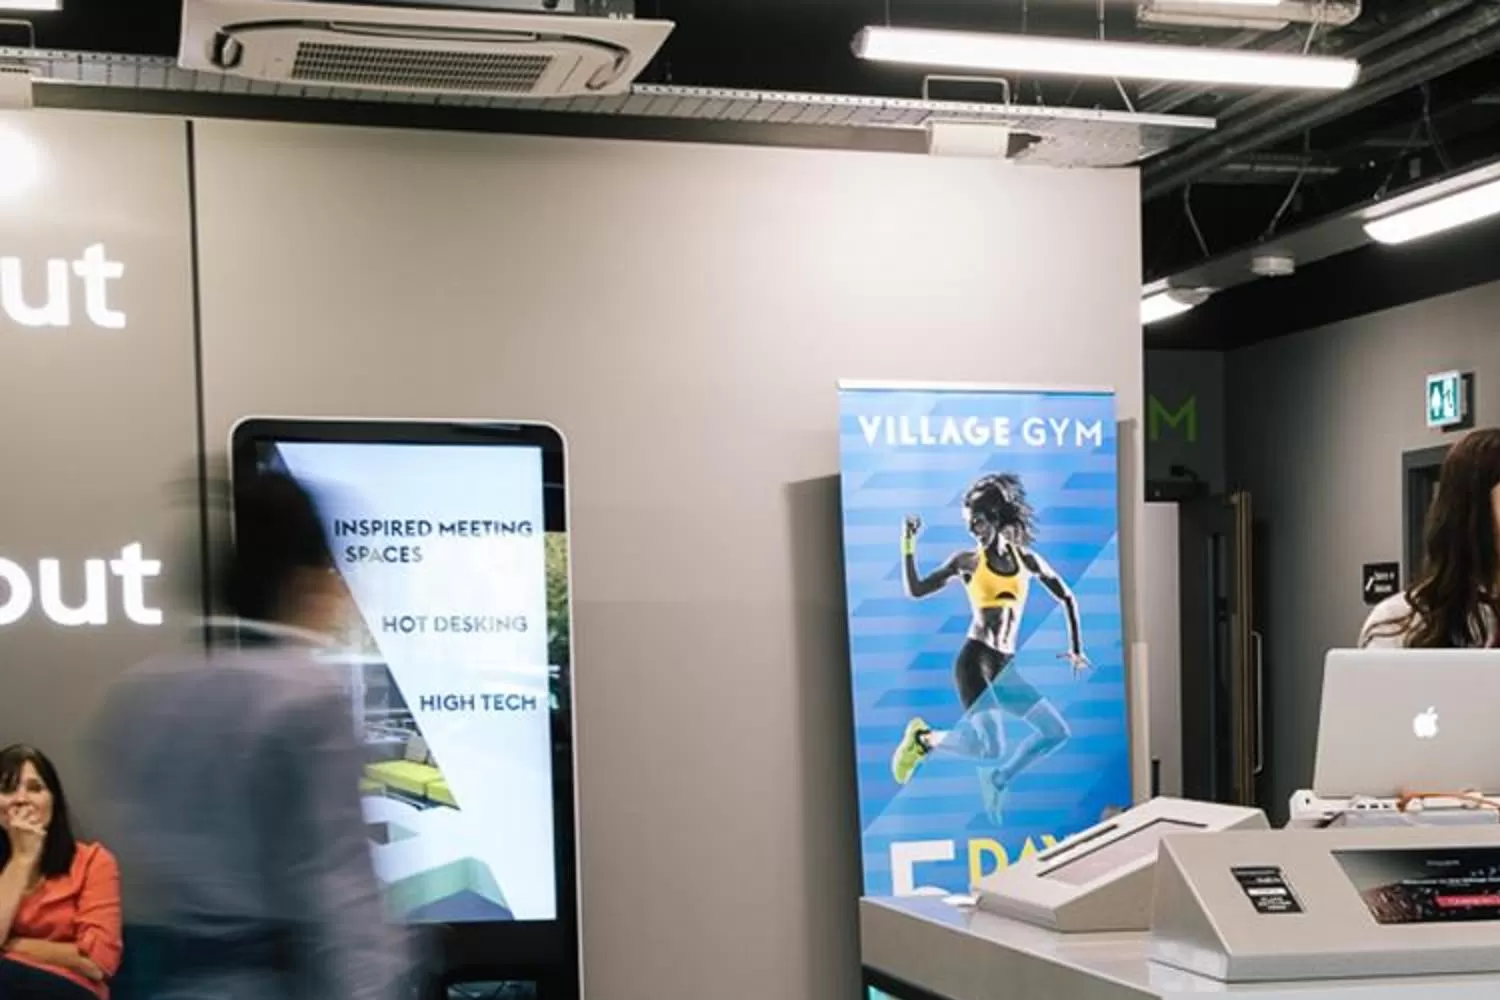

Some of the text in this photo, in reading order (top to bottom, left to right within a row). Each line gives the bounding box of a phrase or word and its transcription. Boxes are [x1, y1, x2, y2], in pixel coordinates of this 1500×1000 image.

[857, 415, 1103, 447] VILLAGE GYM
[334, 519, 533, 537] INSPIRED MEETING
[345, 546, 423, 563] SPACES
[382, 615, 529, 633] HOT DESKING
[419, 694, 537, 711] HIGH TECH
